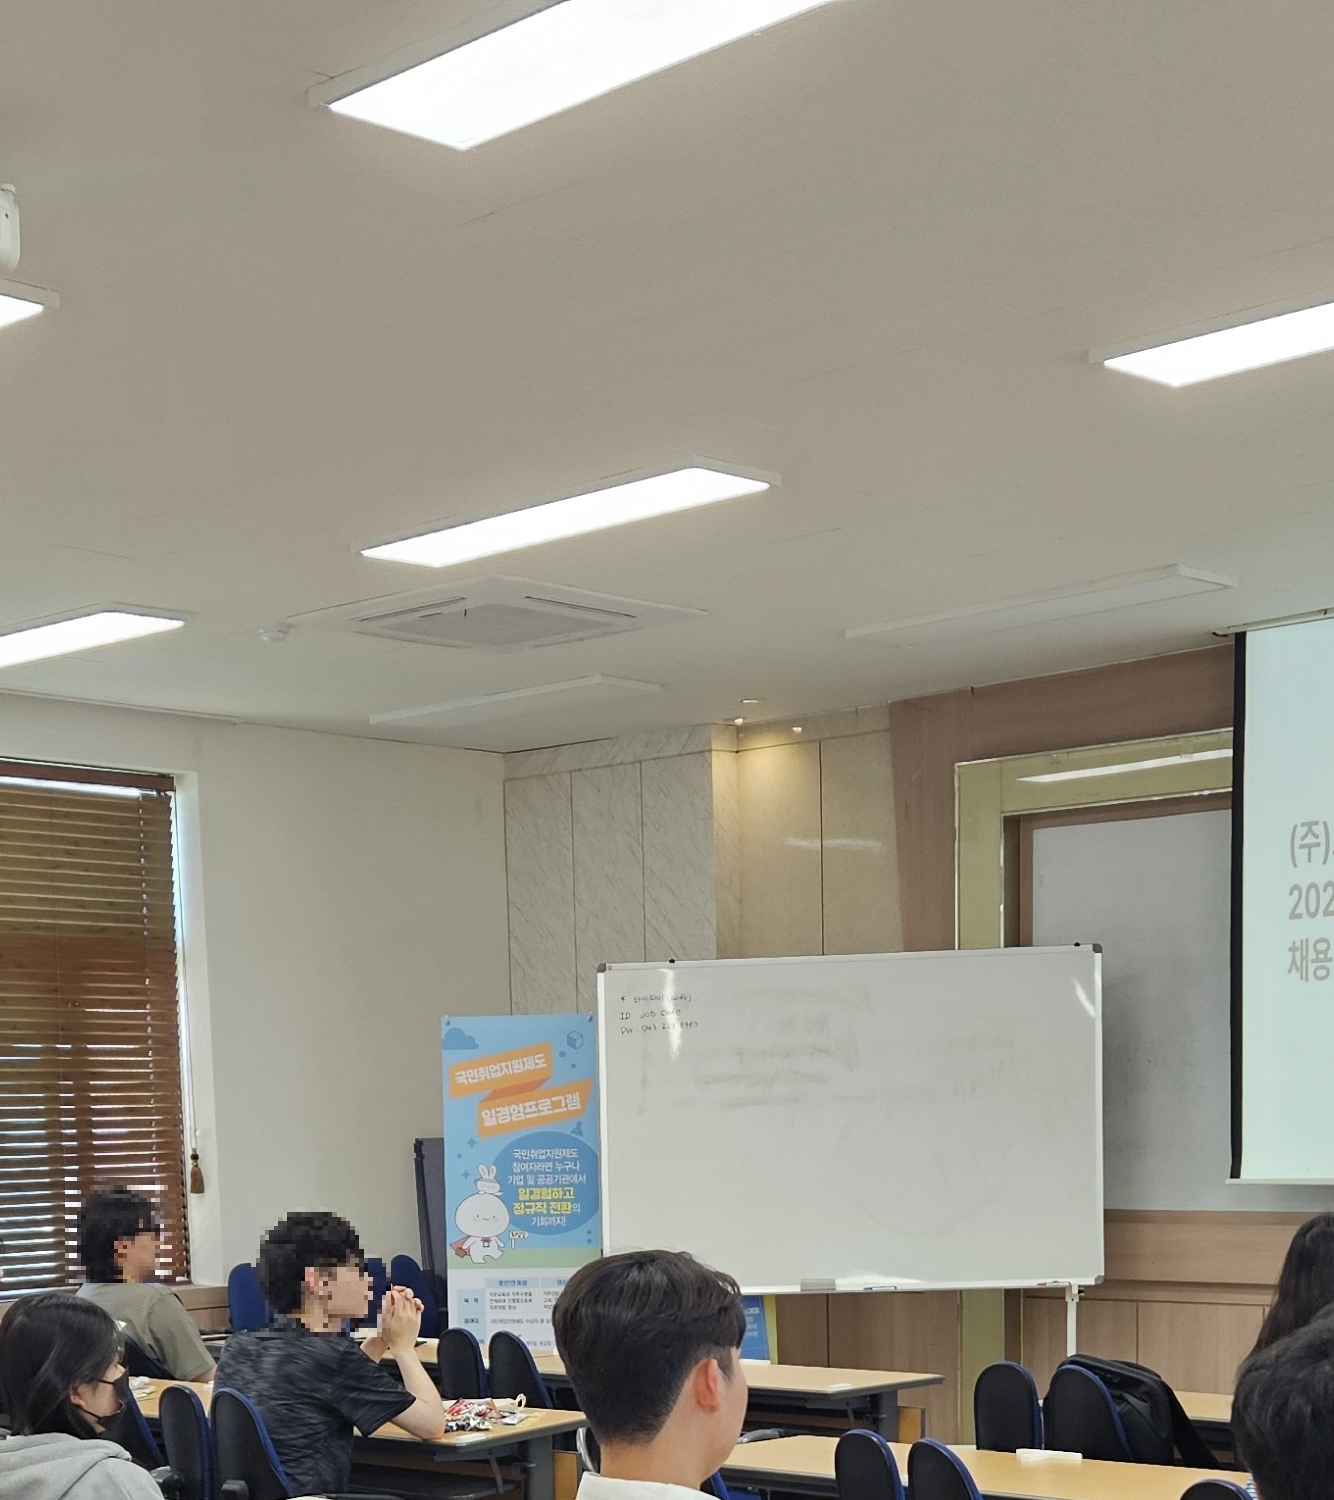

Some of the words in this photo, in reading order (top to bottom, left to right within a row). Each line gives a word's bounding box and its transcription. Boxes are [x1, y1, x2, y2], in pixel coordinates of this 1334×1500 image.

[1287, 937, 1334, 983] 채용
[455, 1053, 547, 1085] 국민취업지원제도
[481, 1092, 582, 1127] 일경험프로그램
[555, 1161, 580, 1172] 누구나
[508, 1174, 524, 1186] 기업
[526, 1174, 535, 1185] 및
[537, 1173, 587, 1185] 공공기관에서
[518, 1187, 575, 1200] 일경험하고
[513, 1201, 547, 1215] 정규직
[549, 1201, 581, 1214] 전환의
